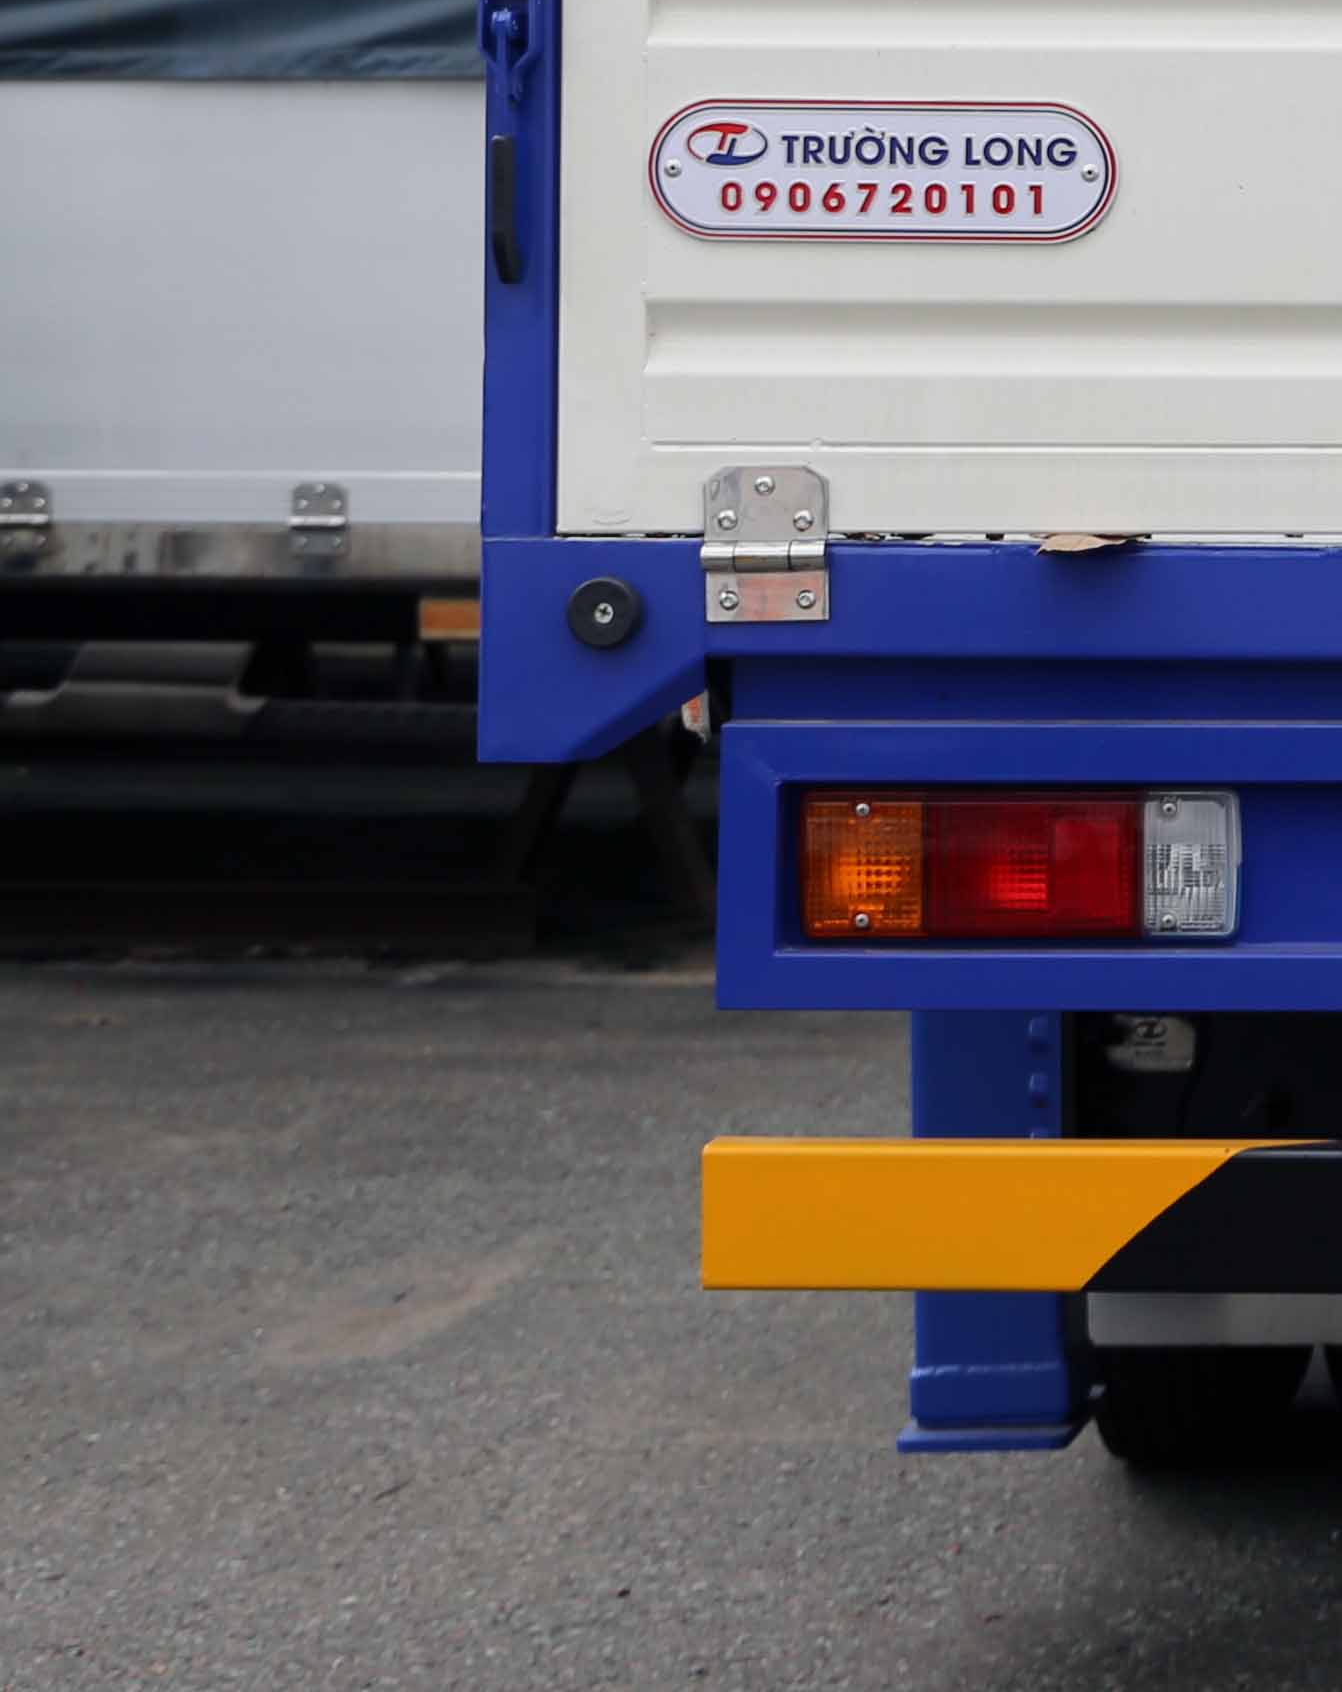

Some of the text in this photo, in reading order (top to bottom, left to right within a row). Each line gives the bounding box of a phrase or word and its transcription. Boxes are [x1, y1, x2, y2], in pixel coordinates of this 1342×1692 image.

[781, 124, 949, 166] TRƯỜNG
[964, 134, 1078, 167] LONG
[720, 181, 1045, 216] 0906720101
